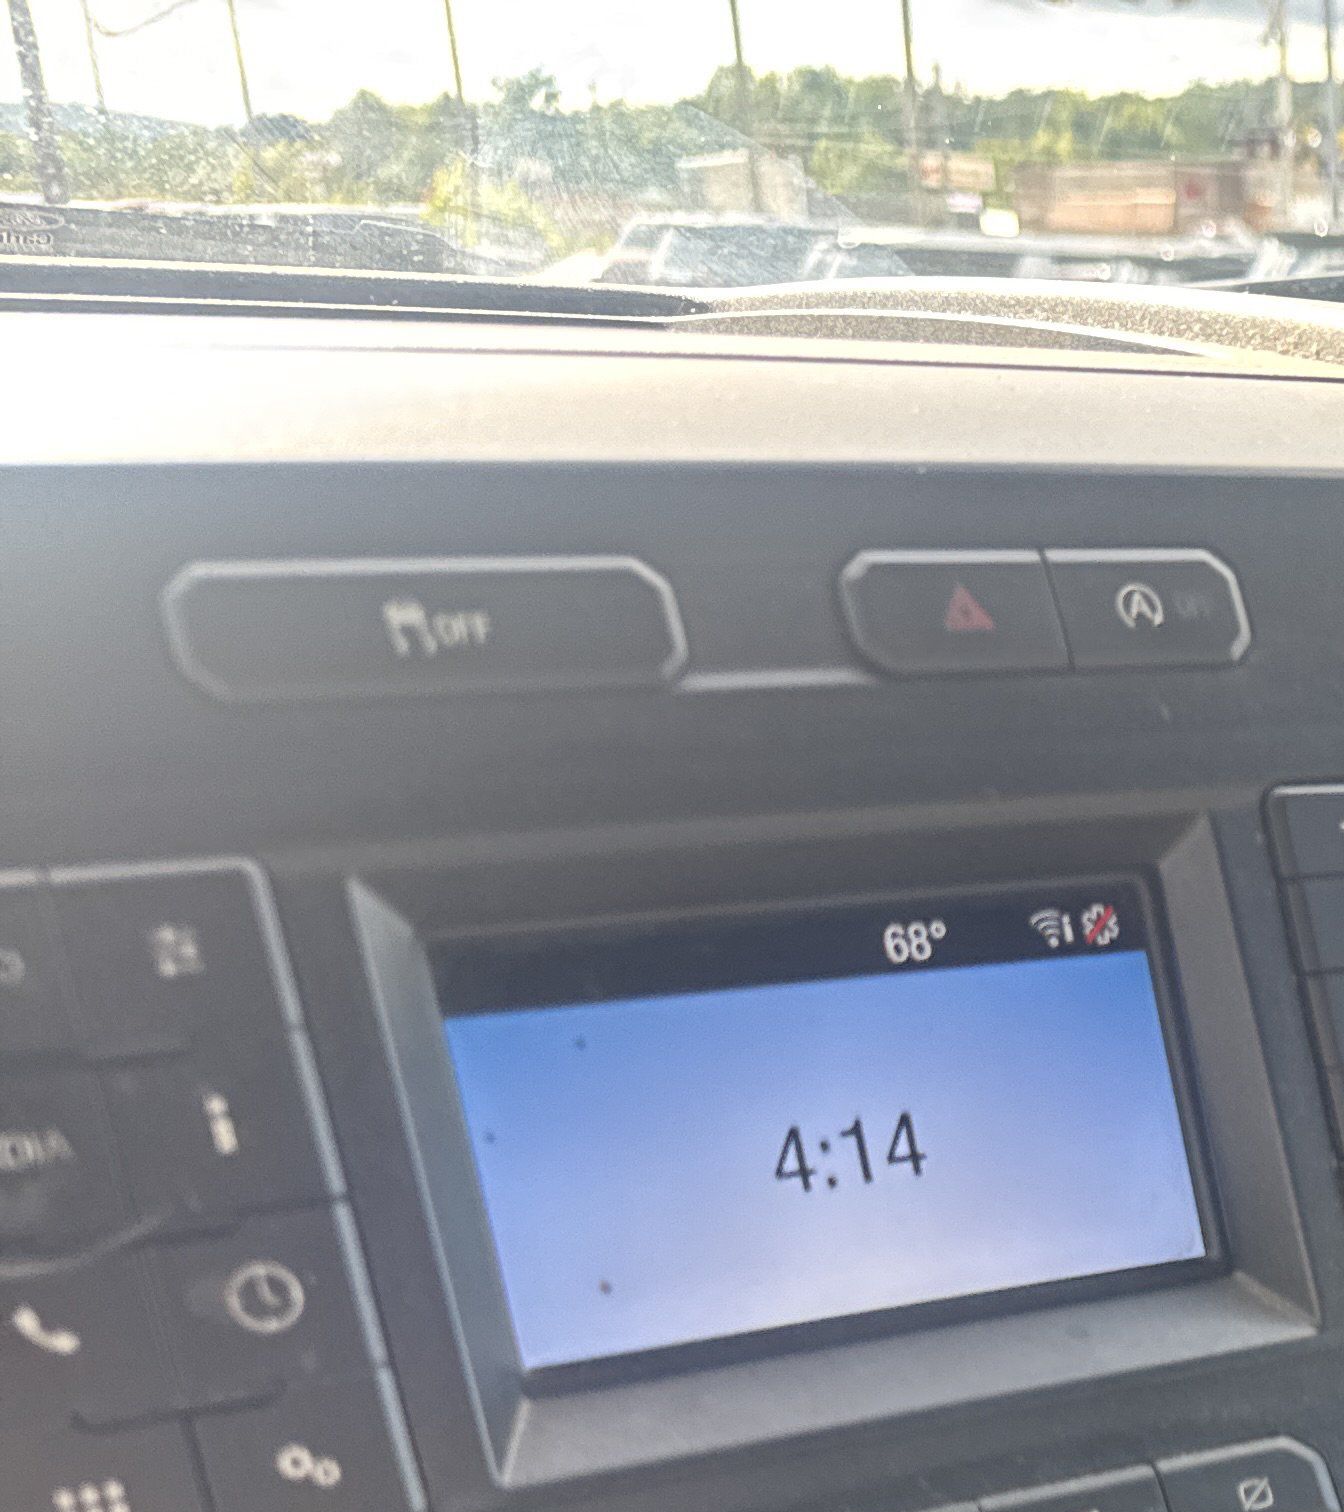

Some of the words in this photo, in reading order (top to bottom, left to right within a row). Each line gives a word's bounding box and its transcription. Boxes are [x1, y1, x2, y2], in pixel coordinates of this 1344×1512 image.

[433, 611, 491, 647] OFF
[0, 1129, 74, 1170] DIA
[775, 1111, 927, 1193] 4:14
